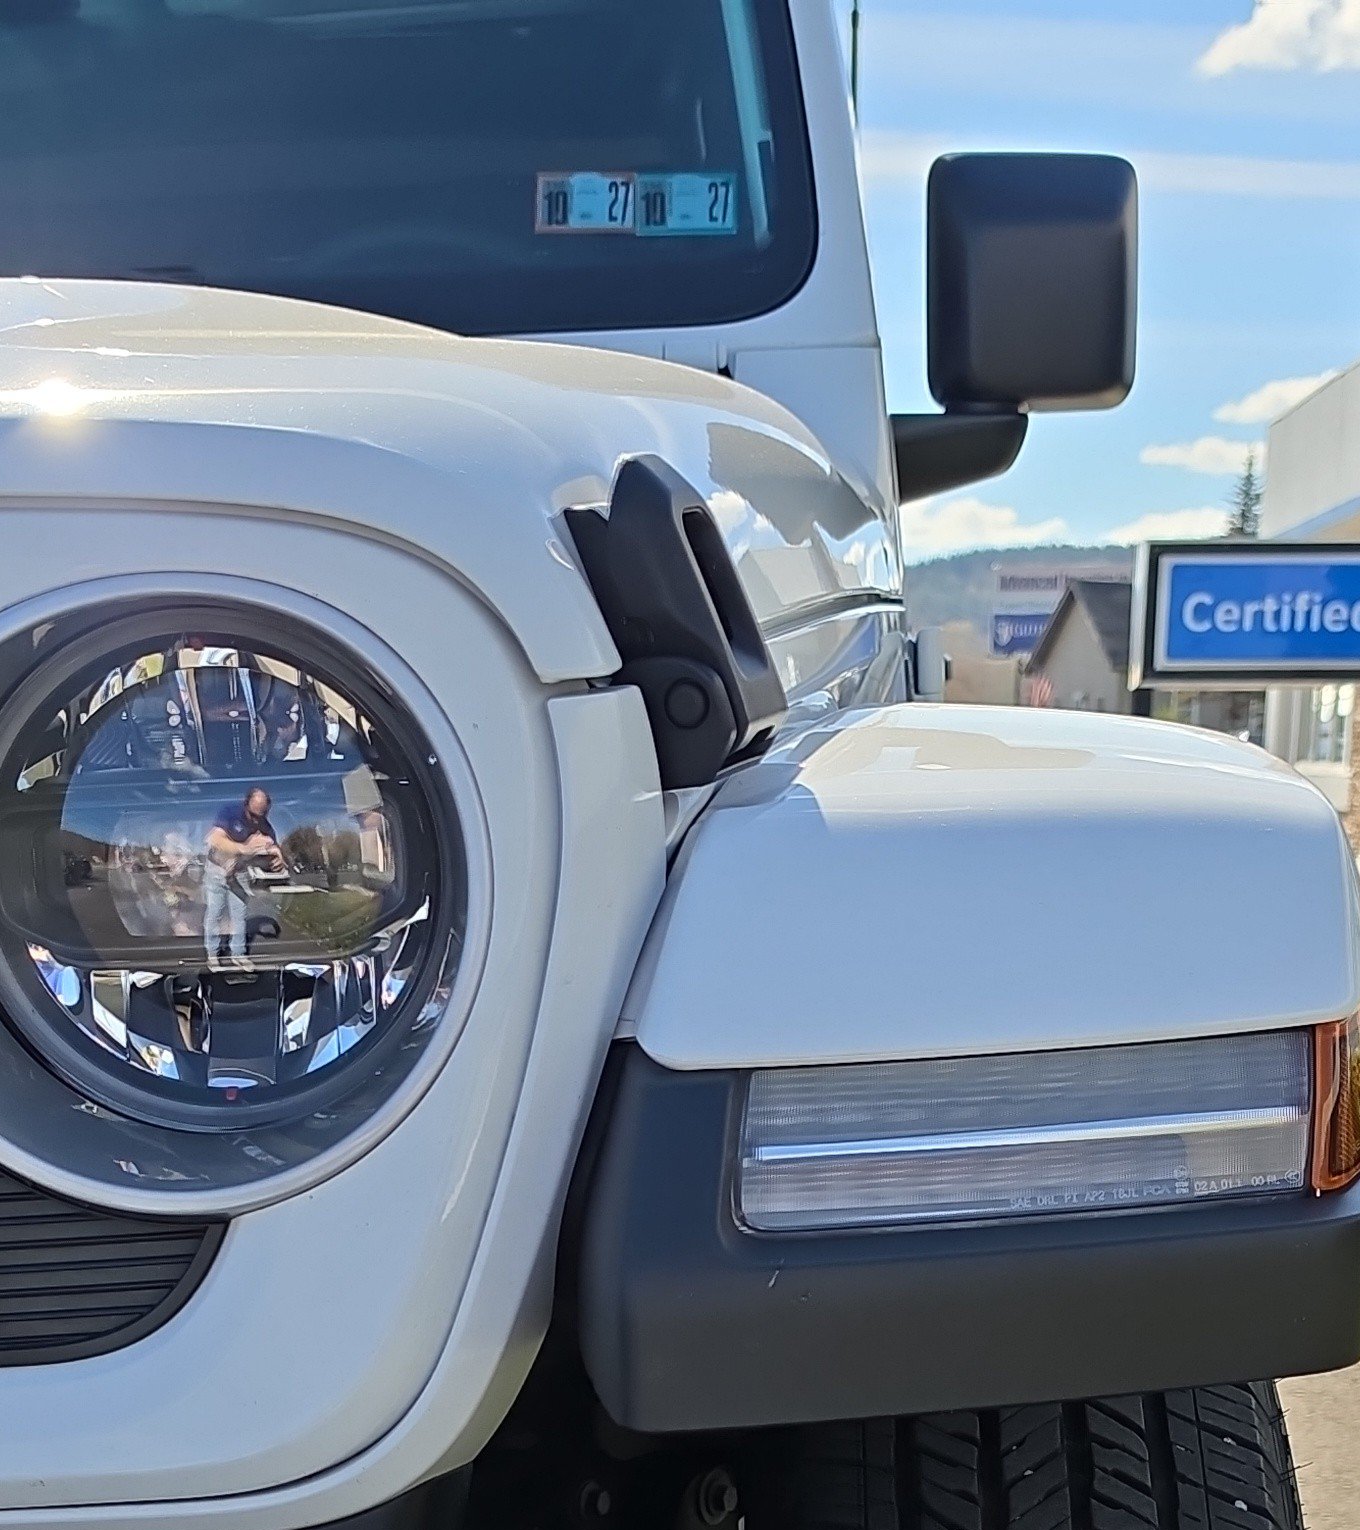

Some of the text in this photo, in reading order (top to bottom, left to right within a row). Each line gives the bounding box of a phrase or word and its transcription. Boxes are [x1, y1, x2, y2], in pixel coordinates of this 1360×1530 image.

[544, 180, 631, 226] 10 27
[641, 181, 731, 227] 10 27
